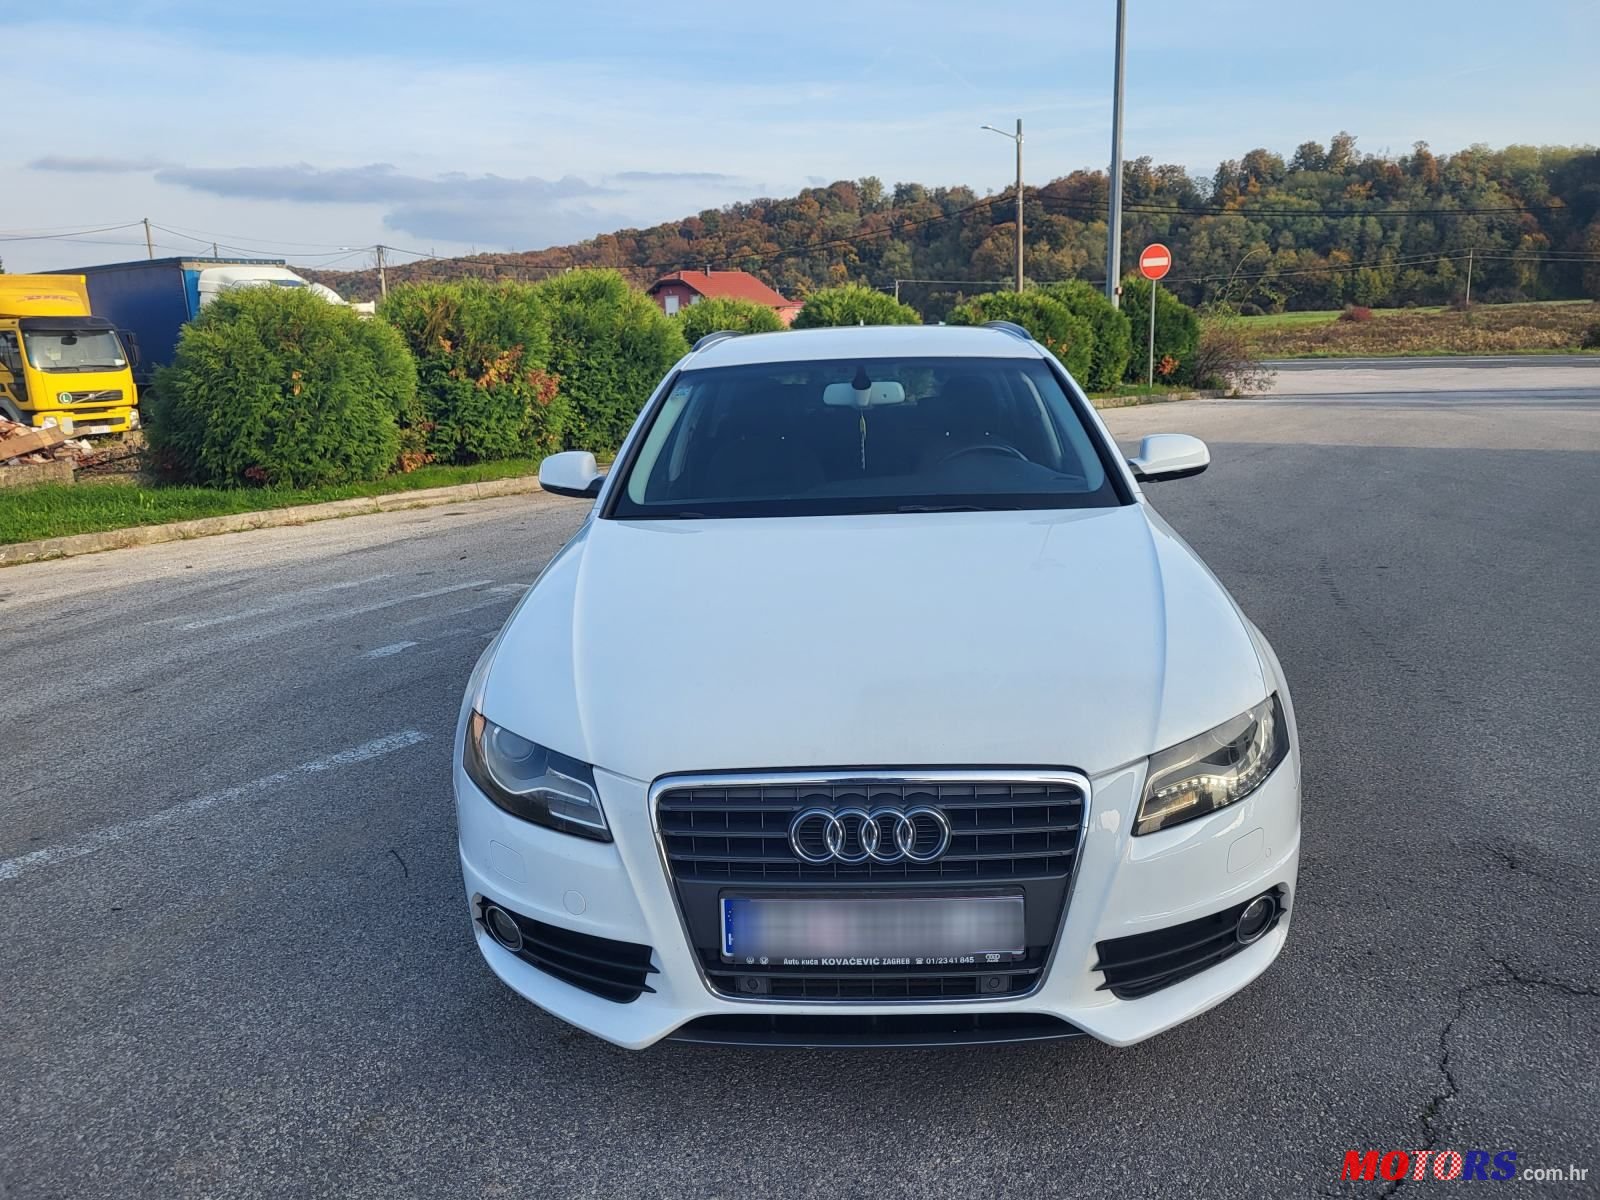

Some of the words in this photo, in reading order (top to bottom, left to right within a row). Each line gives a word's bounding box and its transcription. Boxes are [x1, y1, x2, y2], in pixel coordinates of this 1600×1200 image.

[783, 957, 799, 965] Auto
[882, 957, 910, 966] ZAGREB
[959, 956, 975, 964] 845
